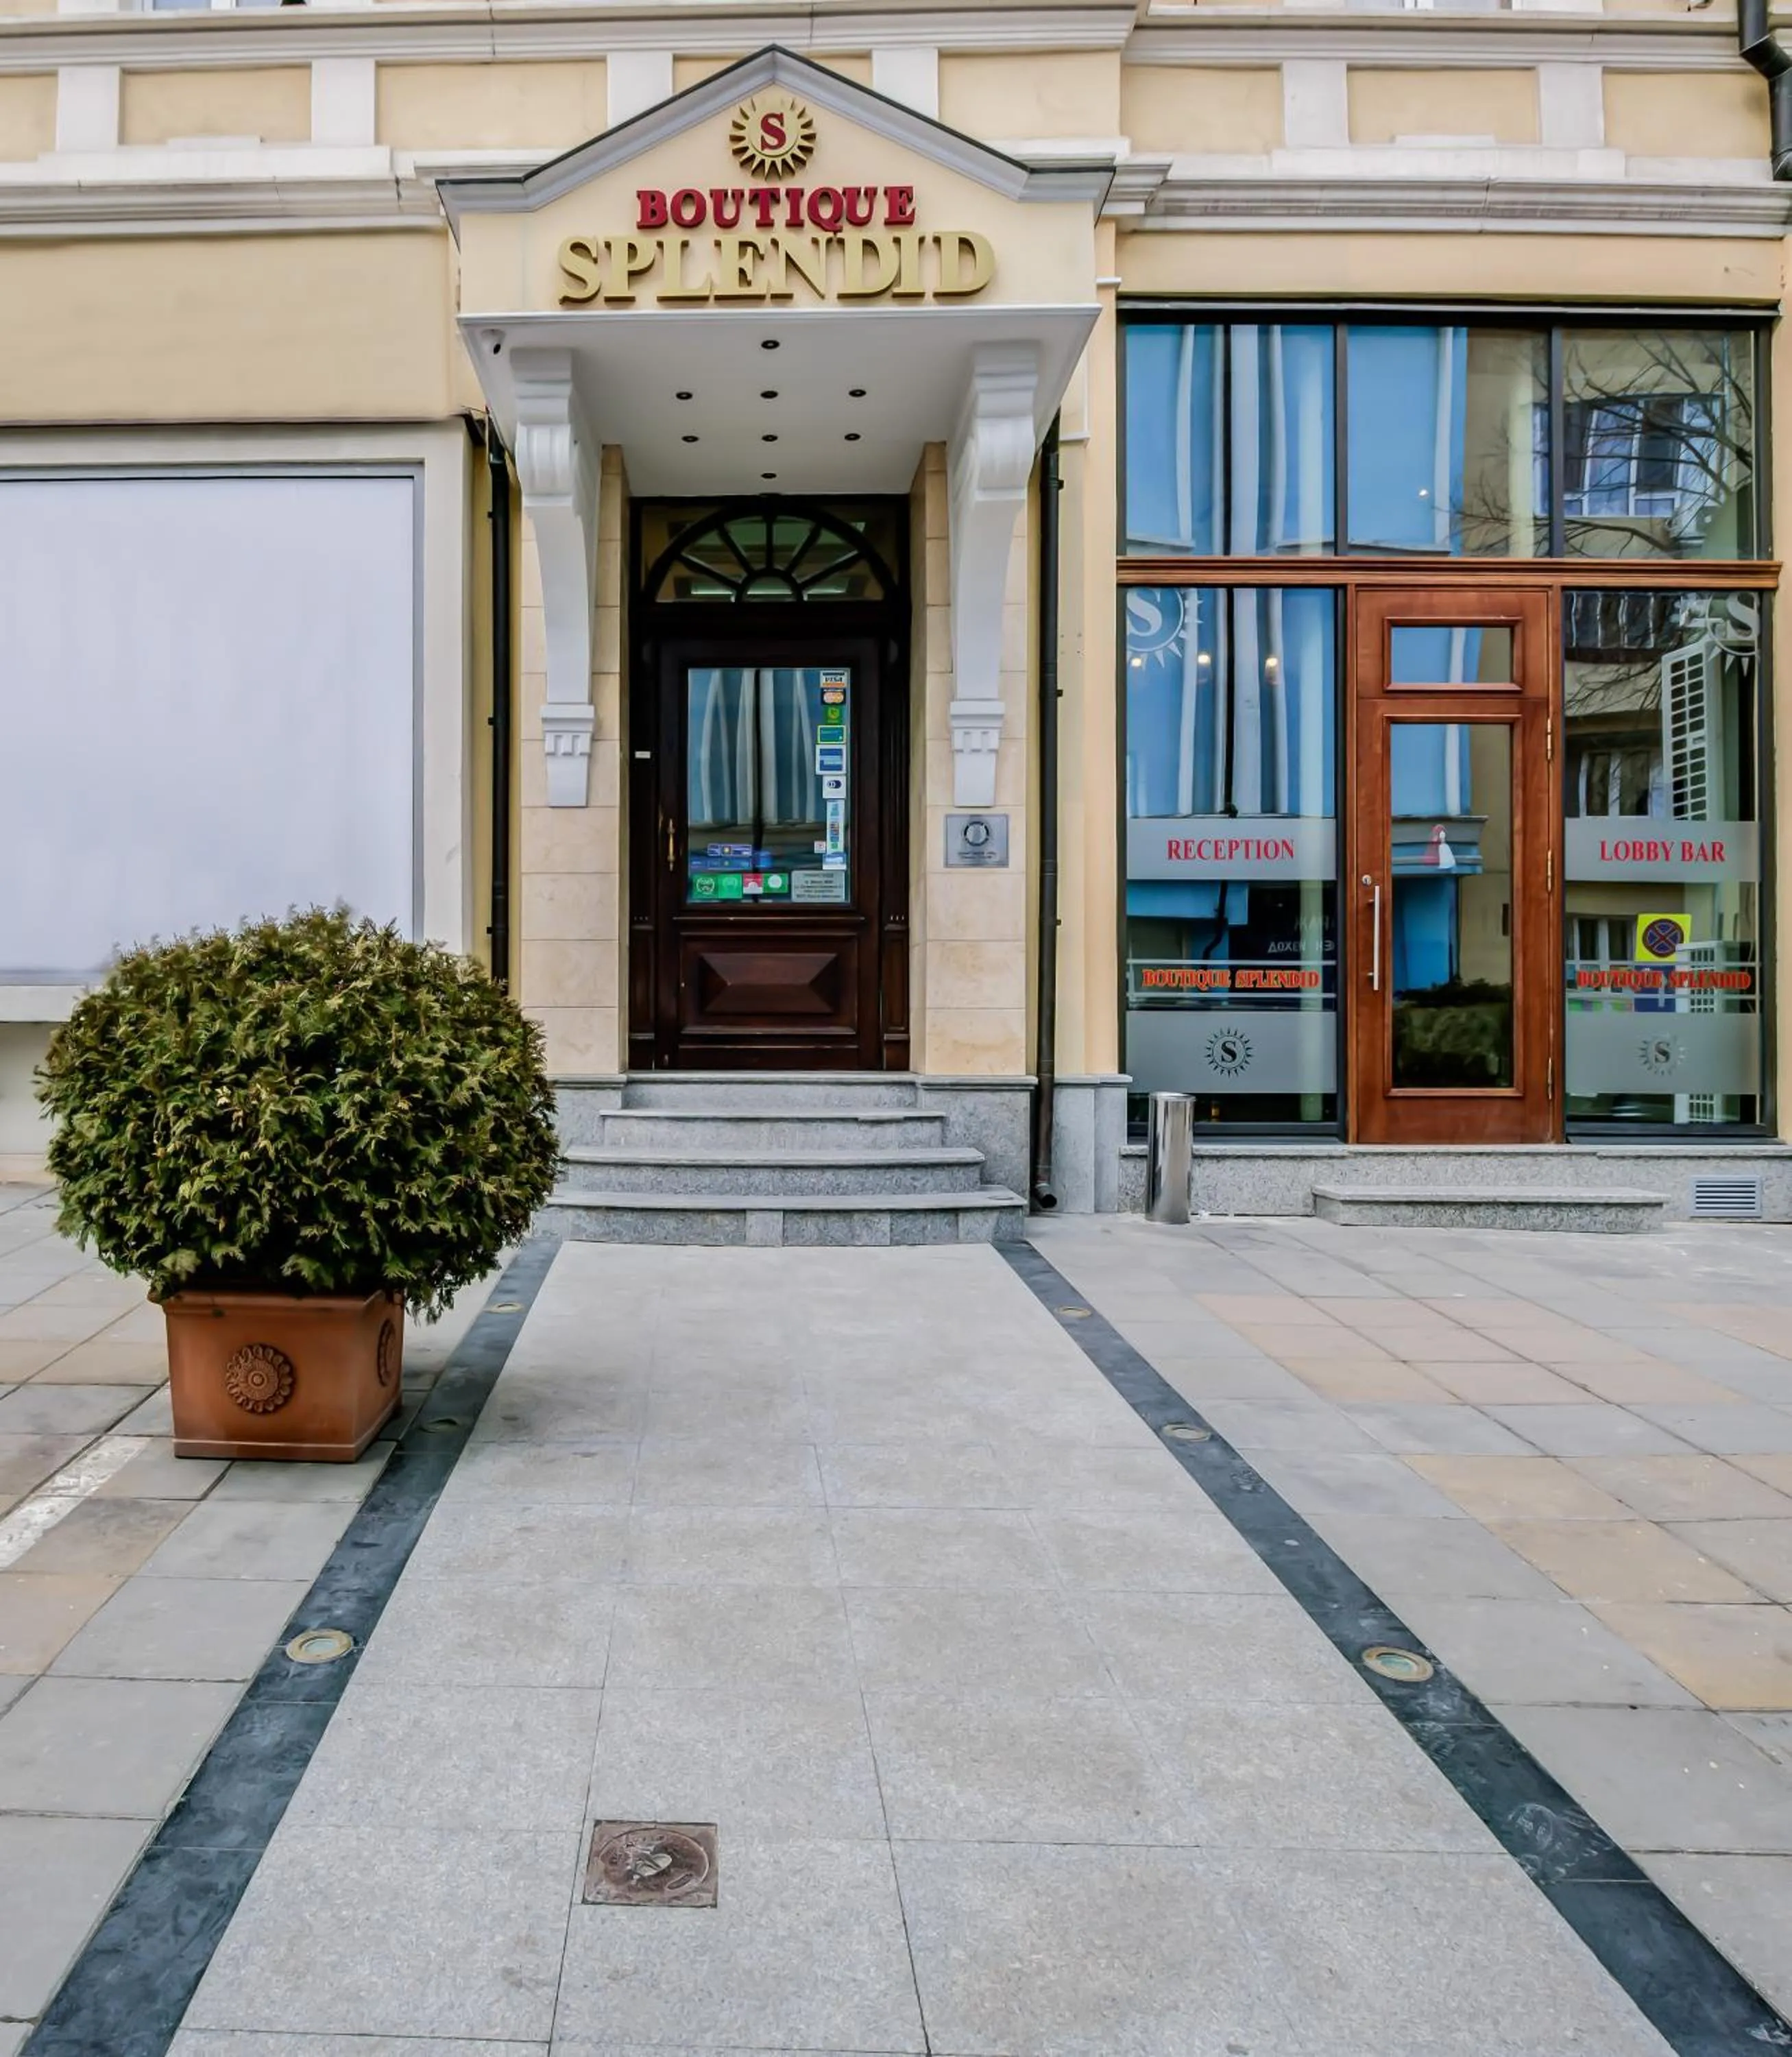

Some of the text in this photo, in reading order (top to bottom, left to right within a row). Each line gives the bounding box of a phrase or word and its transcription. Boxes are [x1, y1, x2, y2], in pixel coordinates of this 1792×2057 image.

[760, 112, 787, 152] S
[635, 185, 917, 234] BOUTIQUE
[557, 230, 997, 305] SPLENDID
[1167, 838, 1295, 861] RECEPTION
[1599, 840, 1726, 863] LOBBY BAR
[1141, 968, 1320, 991] BOUTIQUE SPLENDID
[1577, 970, 1752, 992] BOUTIQUE SPLENDID
[1220, 1040, 1237, 1063] S
[1654, 1041, 1671, 1063] S
